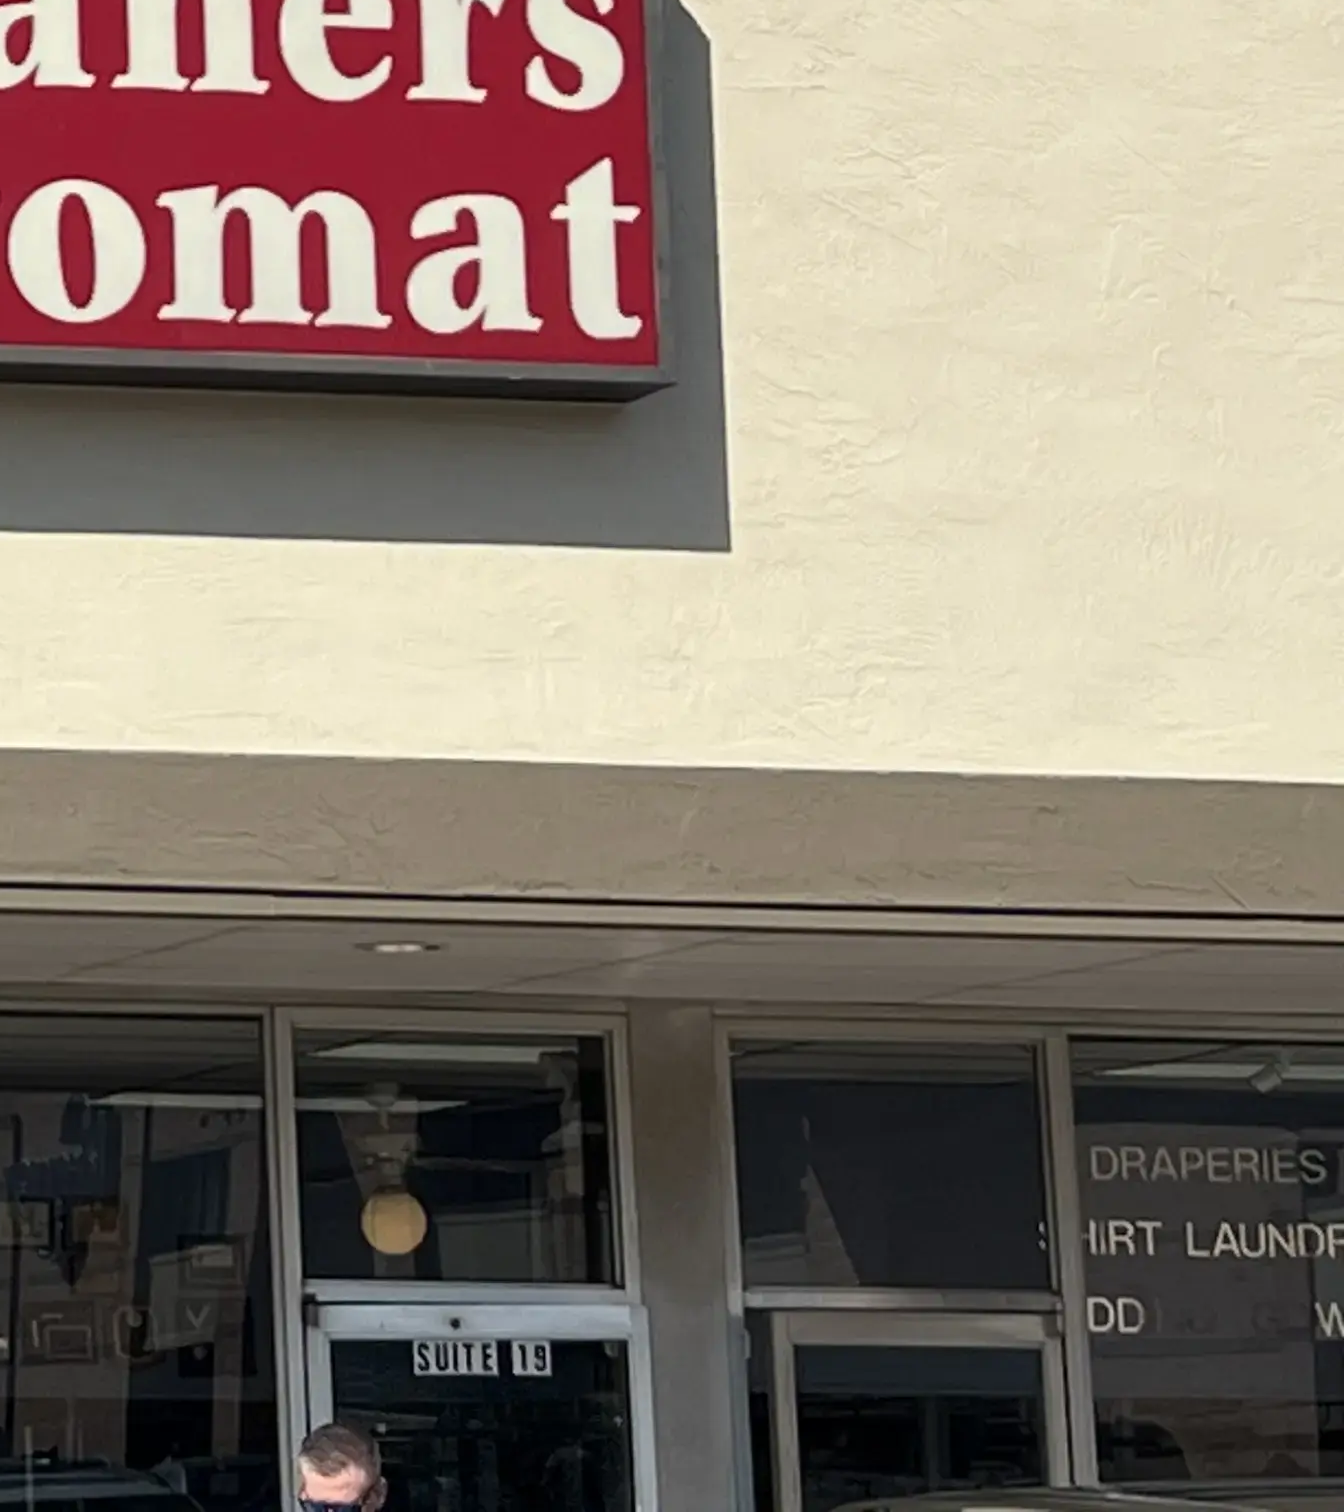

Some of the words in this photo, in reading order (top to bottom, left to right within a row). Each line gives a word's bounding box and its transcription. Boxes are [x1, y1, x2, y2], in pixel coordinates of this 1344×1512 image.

[1089, 1145, 1328, 1184] DRAPERIES
[417, 1342, 493, 1372] SUITE
[518, 1343, 547, 1372] 19
